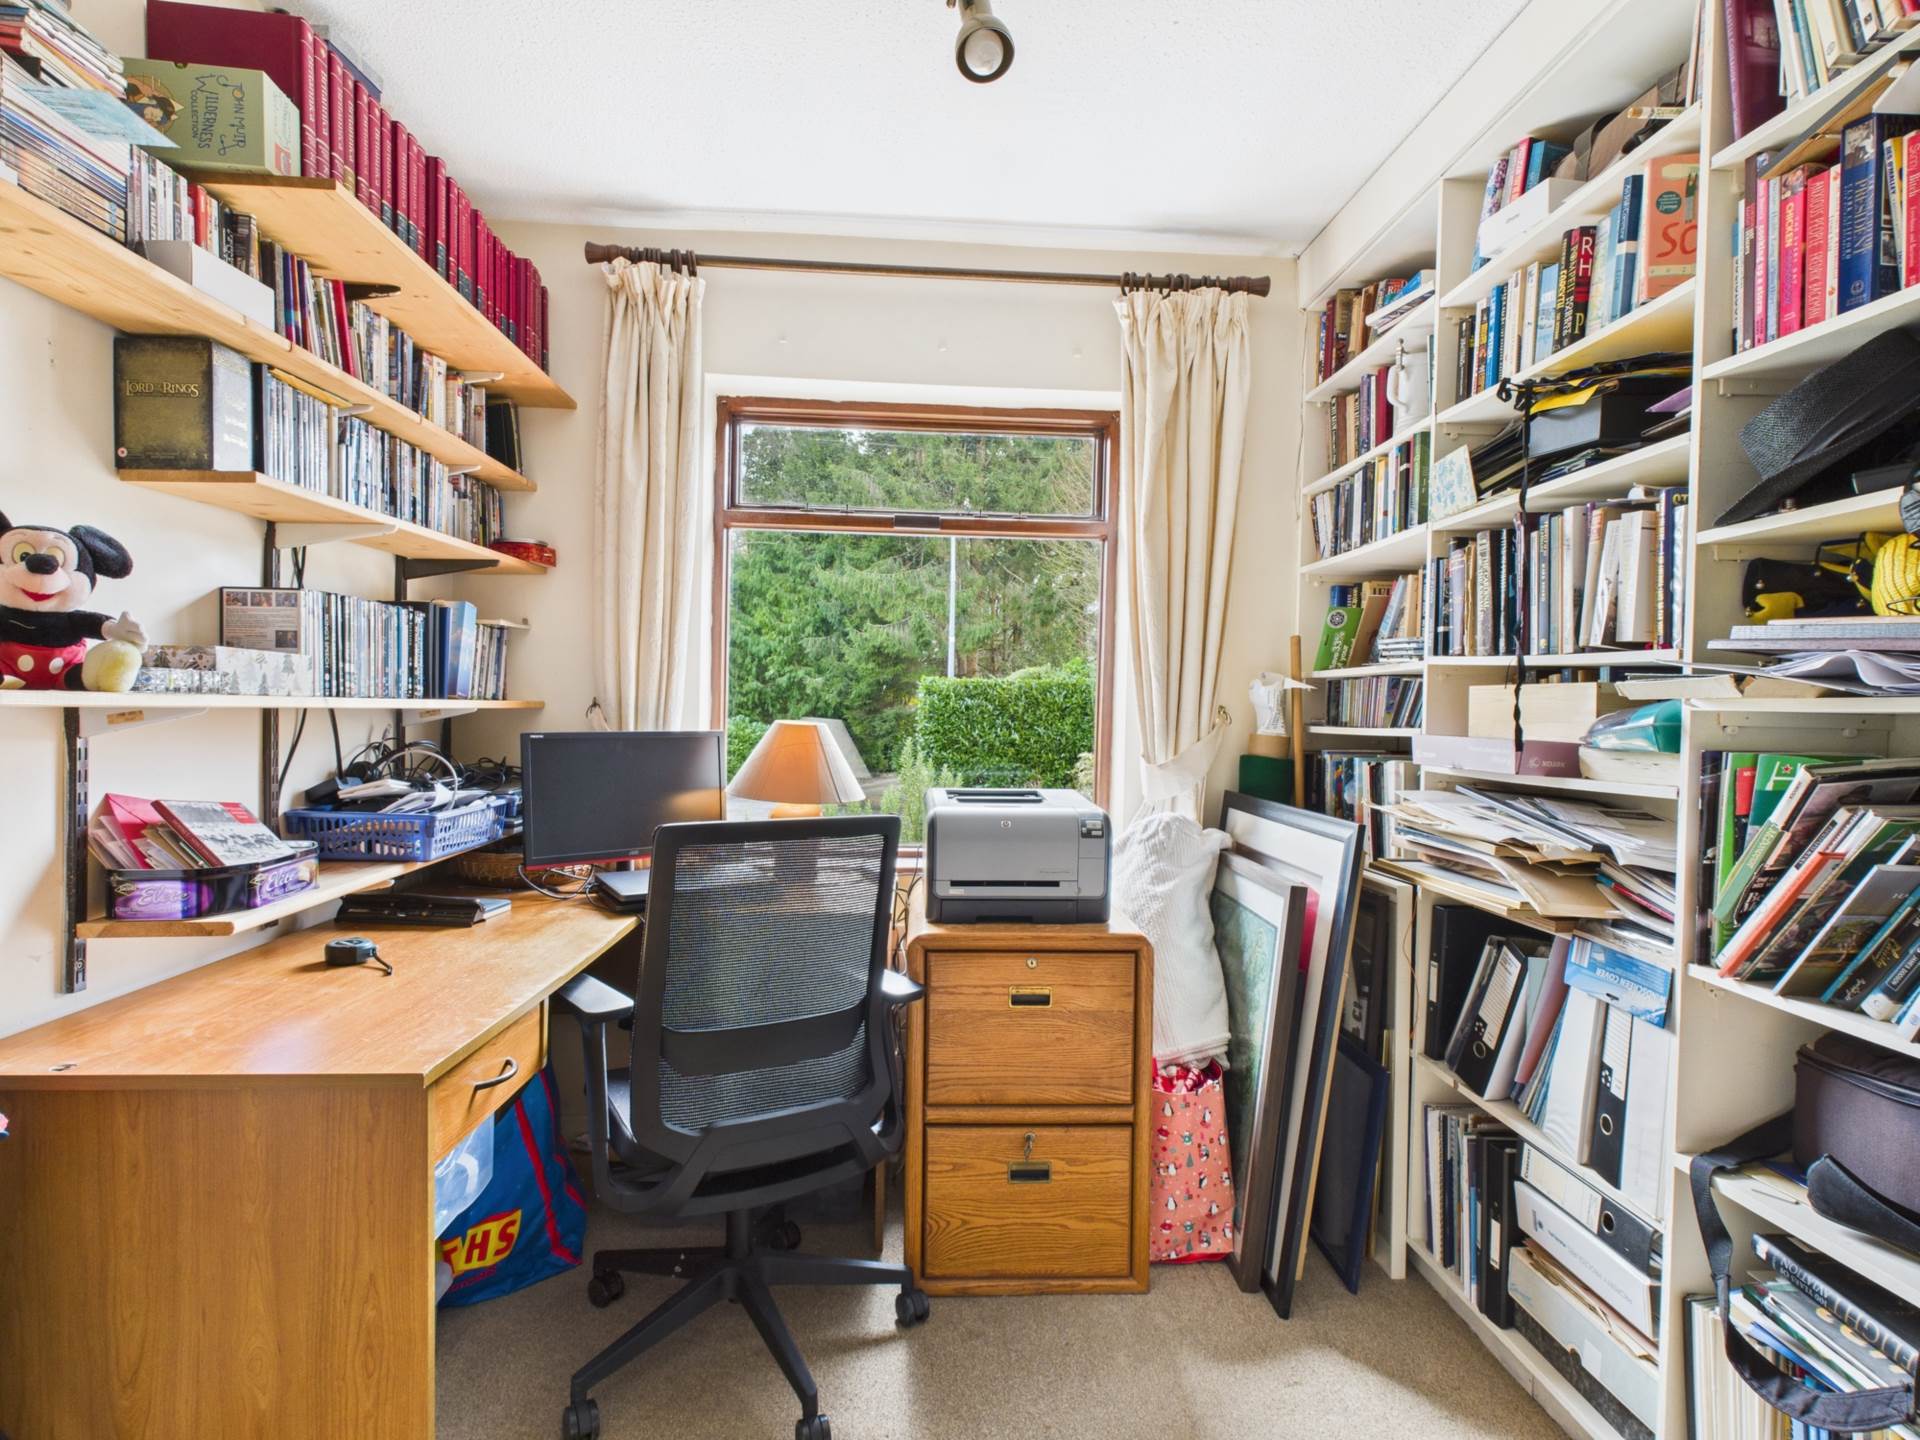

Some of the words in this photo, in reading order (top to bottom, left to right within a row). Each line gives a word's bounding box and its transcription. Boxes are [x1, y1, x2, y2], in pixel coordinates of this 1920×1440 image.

[195, 74, 219, 150] WILDERNESS
[216, 74, 244, 114] JOHN
[190, 90, 198, 138] COLLECTION
[218, 117, 246, 156] MUIR
[1809, 180, 1824, 217] ANXIOUS
[1784, 202, 1794, 248] CHICKEN
[1808, 218, 1824, 248] PEOPLE
[1582, 236, 1593, 256] R
[1579, 258, 1592, 277] H
[126, 380, 154, 396] LORD
[163, 382, 199, 398] RINGS
[1778, 1256, 1831, 1299] AVIATION
